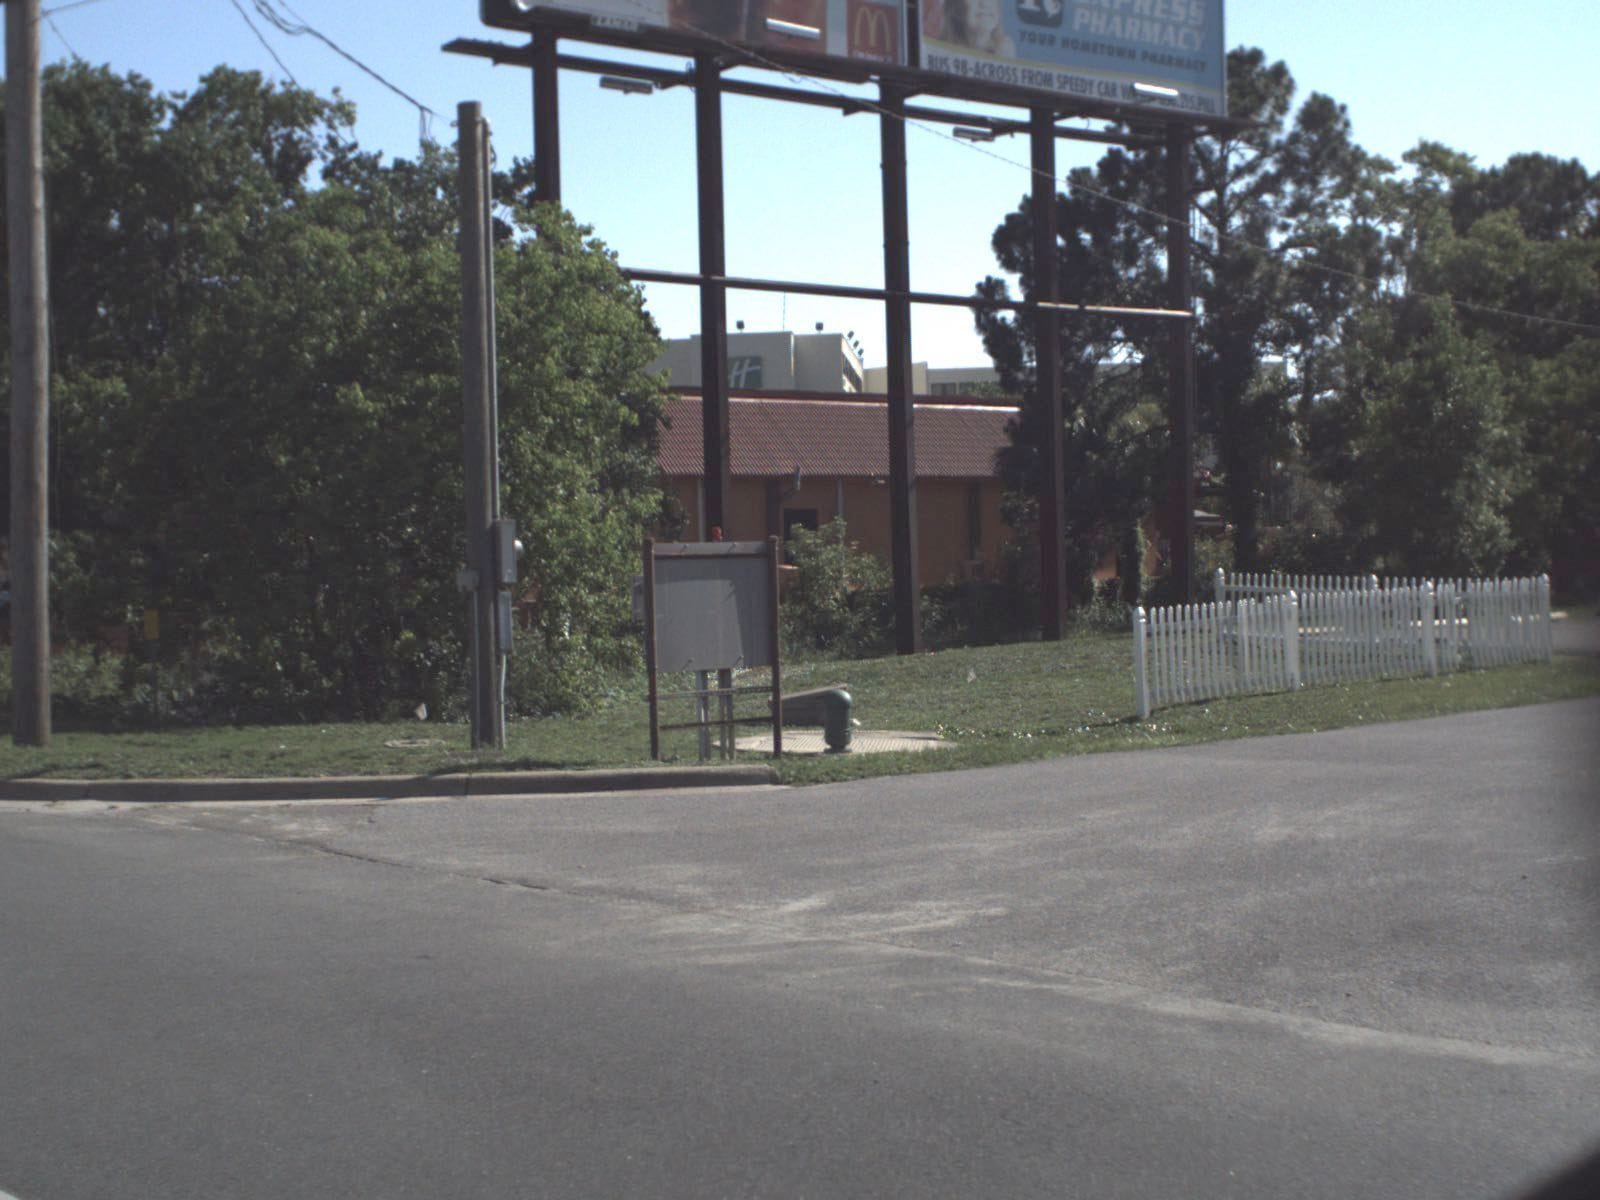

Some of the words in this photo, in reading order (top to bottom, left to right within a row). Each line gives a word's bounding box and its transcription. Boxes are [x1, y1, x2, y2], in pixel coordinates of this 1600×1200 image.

[1072, 0, 1206, 25] RESS
[1073, 7, 1206, 52] PHARMACY
[1019, 30, 1056, 46] YOUR
[1061, 36, 1137, 60] HOMETOWN
[1021, 67, 1053, 87] FROM
[1056, 73, 1096, 94] SPEEDY
[1097, 79, 1117, 98] CAR
